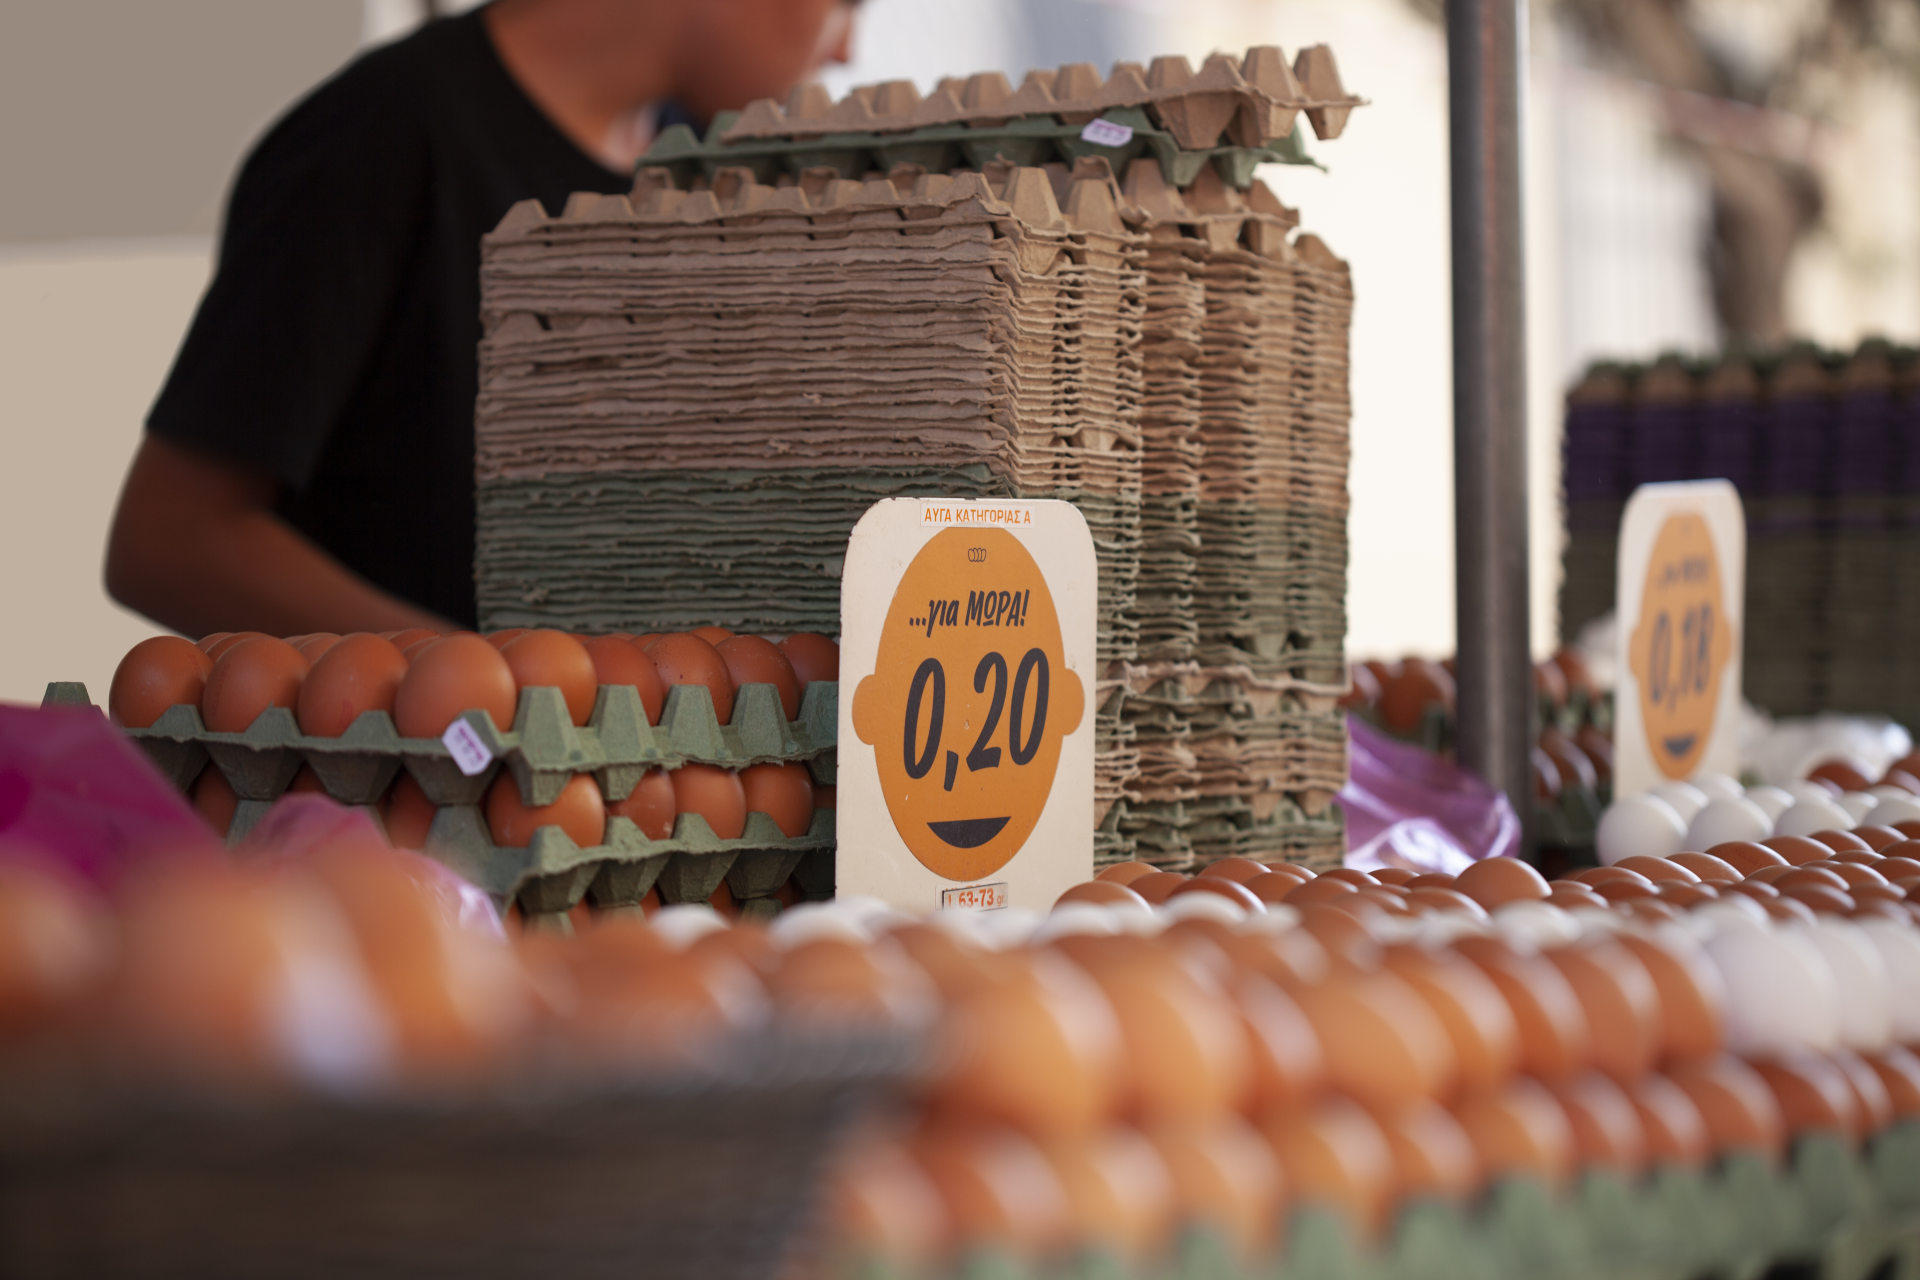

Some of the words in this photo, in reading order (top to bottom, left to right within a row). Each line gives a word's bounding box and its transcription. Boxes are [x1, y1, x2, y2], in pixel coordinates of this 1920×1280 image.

[924, 507, 952, 522] ΑΥΓΑ
[956, 508, 1021, 524] ΚΑΤΗΓΟΡΙΑΣ
[1023, 510, 1031, 524] Α
[964, 589, 1030, 627] ΜΟΡΑ!
[903, 647, 1050, 792] 0,20
[958, 887, 995, 908] 63-73
